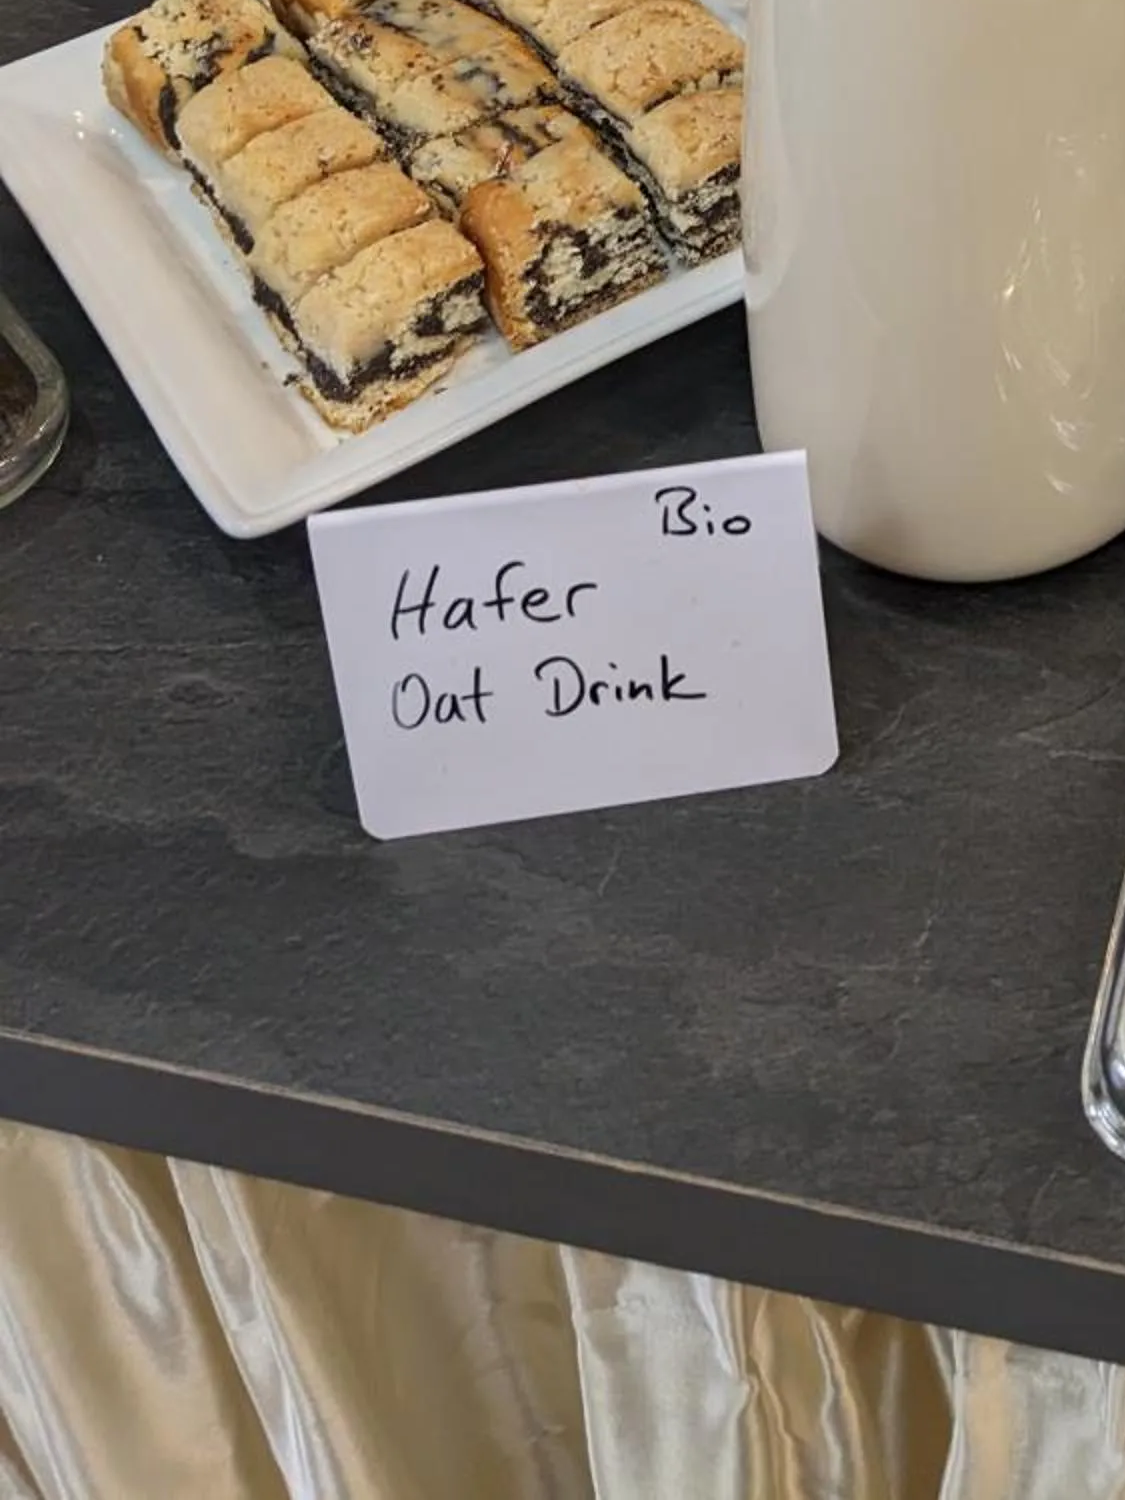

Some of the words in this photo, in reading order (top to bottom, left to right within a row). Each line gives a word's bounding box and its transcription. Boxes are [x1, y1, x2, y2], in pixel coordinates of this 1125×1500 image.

[655, 486, 752, 536] Bio
[390, 560, 598, 641] Hafer
[391, 665, 494, 729] Oat
[534, 654, 708, 717] Drink
